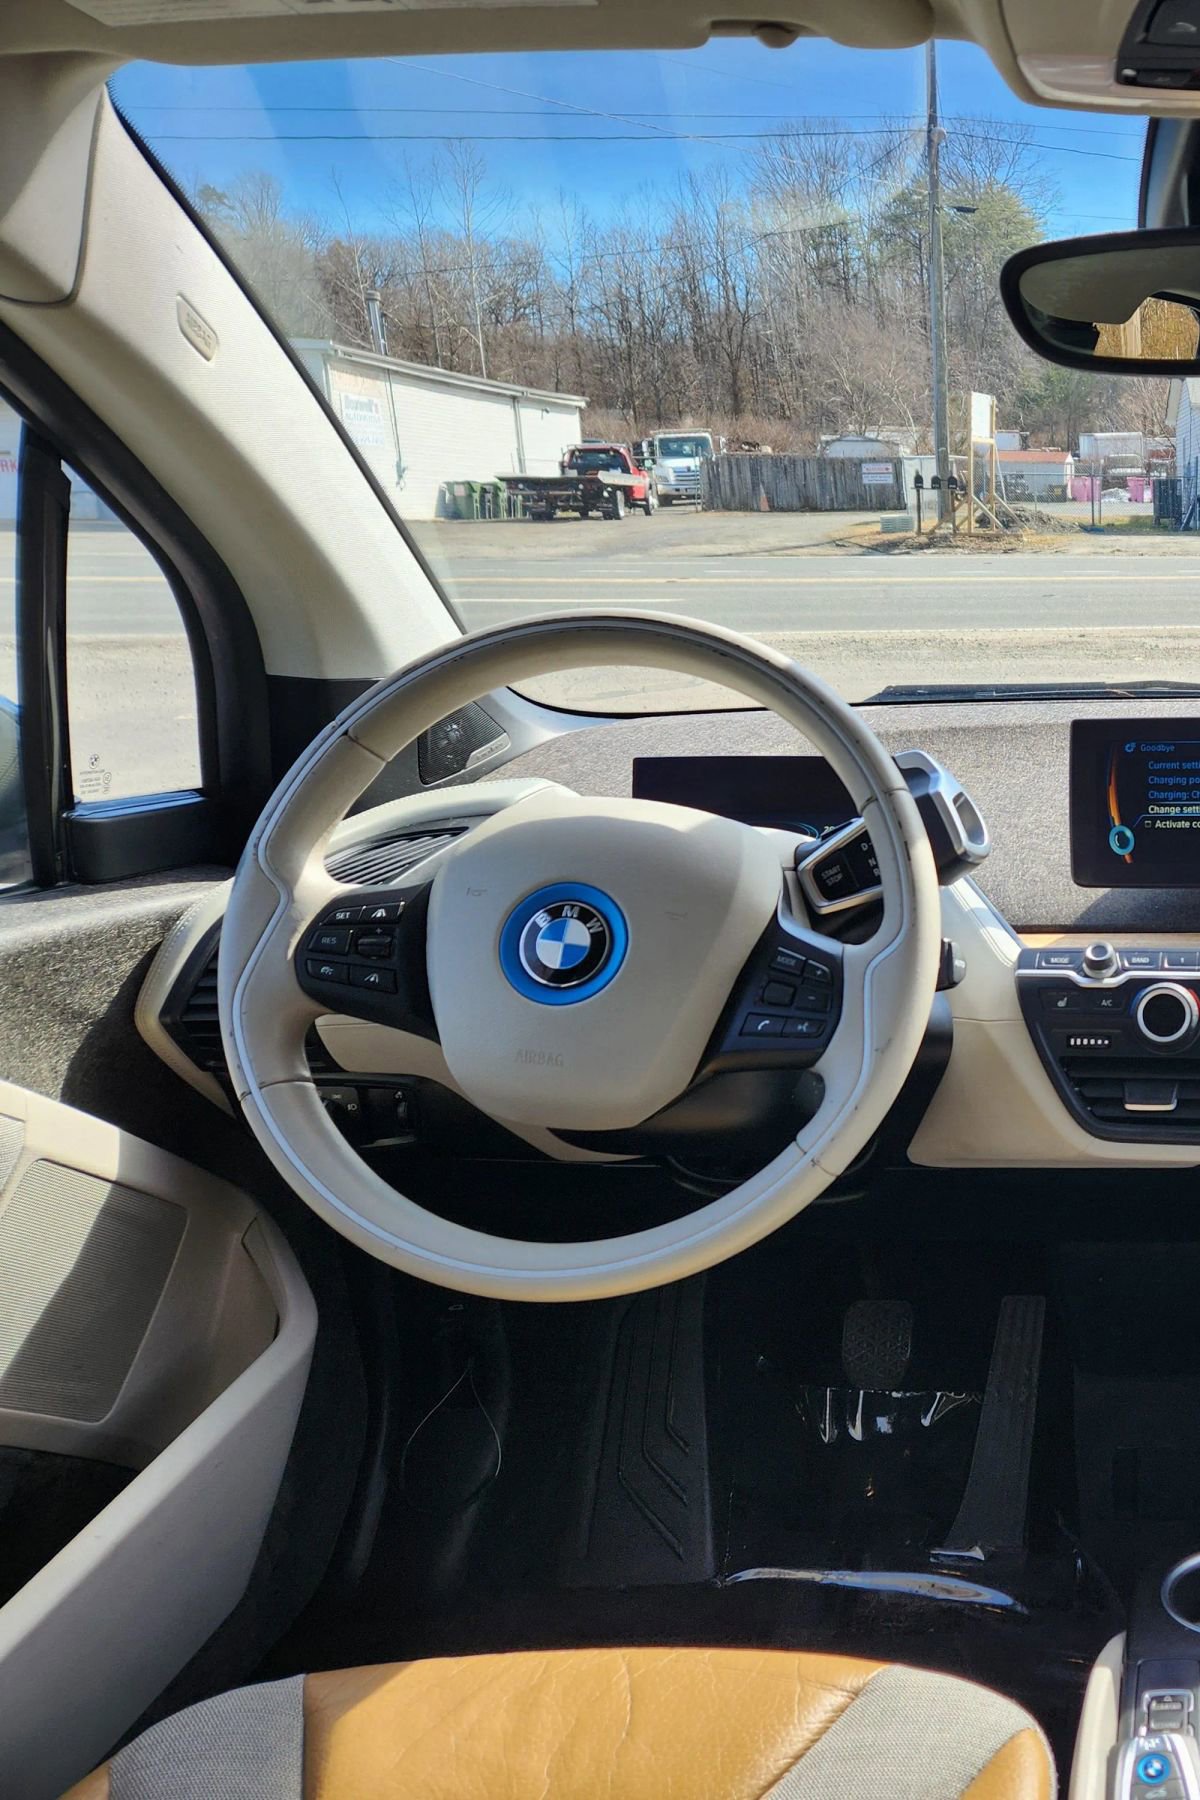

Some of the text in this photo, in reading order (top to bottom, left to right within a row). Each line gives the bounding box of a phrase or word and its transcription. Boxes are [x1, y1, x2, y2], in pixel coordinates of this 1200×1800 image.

[1140, 743, 1175, 753] Goodbye
[1148, 761, 1180, 769] Current
[1148, 776, 1187, 785] Charging
[1148, 790, 1190, 799] Charging:
[1148, 805, 1181, 815] Change
[1155, 819, 1191, 828] Activate
[335, 911, 351, 920] SET
[535, 905, 604, 934] BMW
[321, 936, 337, 944] RES
[1050, 956, 1070, 964] MODE
[1131, 956, 1150, 964] BAND
[1101, 999, 1113, 1007] A/C
[513, 1049, 565, 1067] AIRBAG
